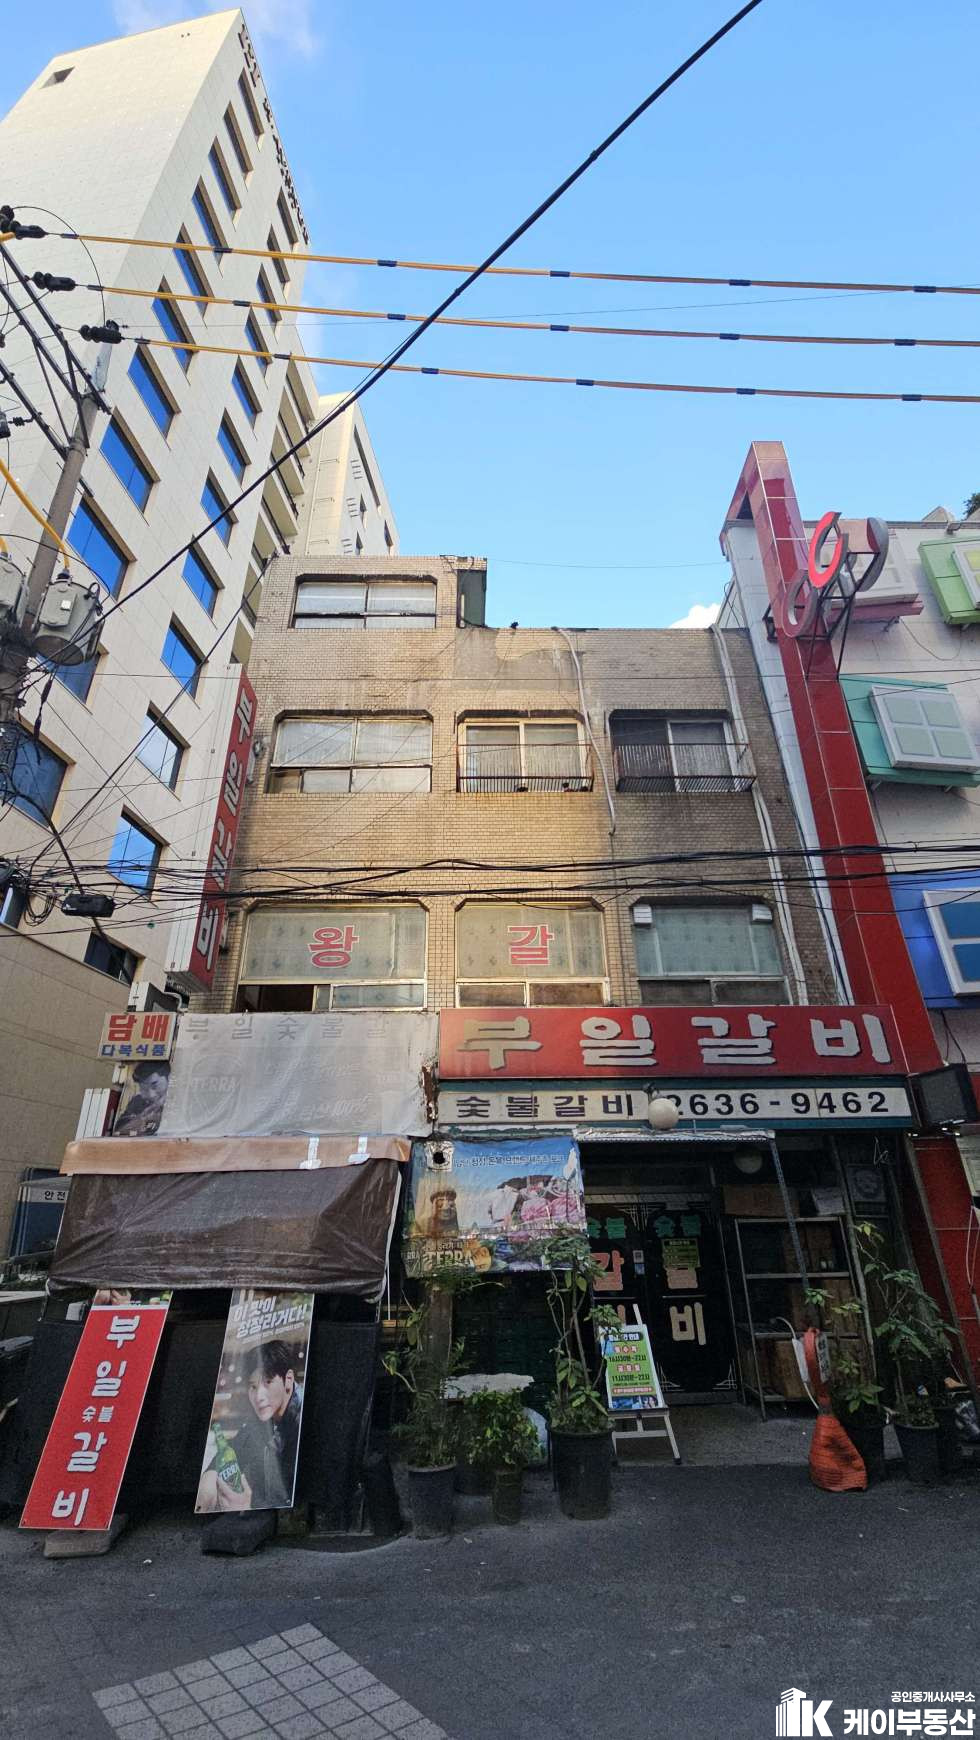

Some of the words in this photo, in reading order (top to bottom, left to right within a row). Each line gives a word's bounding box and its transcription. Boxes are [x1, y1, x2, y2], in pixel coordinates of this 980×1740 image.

[308, 925, 360, 970] 왕
[507, 924, 555, 966] 갈
[108, 1015, 170, 1041] 담배
[101, 1044, 165, 1057] 다복식품
[456, 1014, 891, 1070] 부일갈비
[456, 1094, 634, 1118] 숯불갈비
[669, 1302, 706, 1346] 비
[82, 1405, 114, 1423] 숯불
